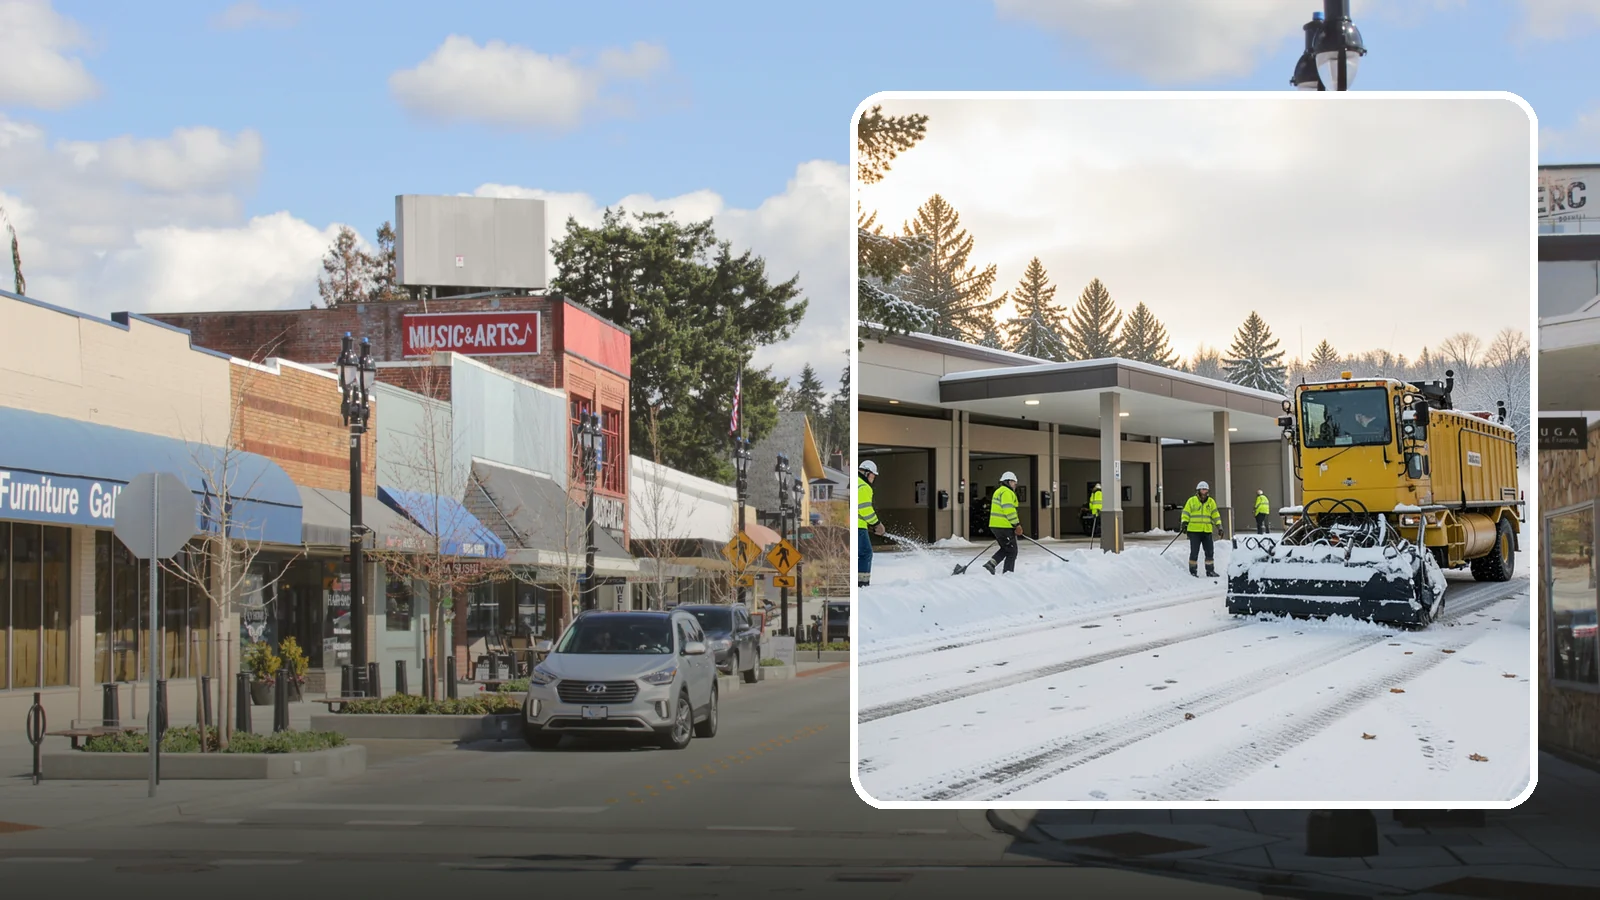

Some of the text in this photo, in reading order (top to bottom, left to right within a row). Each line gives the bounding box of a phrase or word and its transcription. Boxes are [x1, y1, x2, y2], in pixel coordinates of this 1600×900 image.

[0, 471, 122, 519] Furniture Gal
[453, 563, 479, 575] SUSHI
